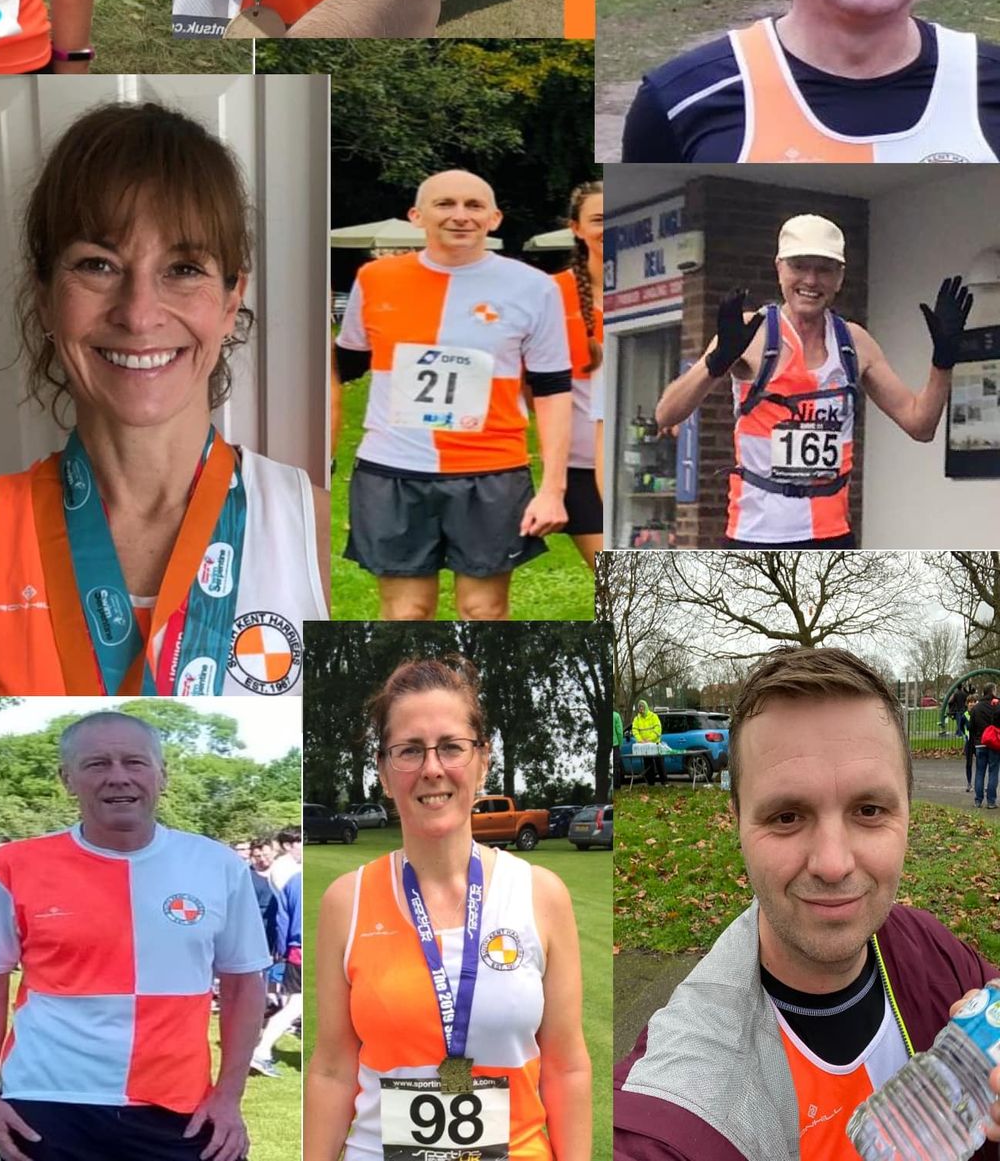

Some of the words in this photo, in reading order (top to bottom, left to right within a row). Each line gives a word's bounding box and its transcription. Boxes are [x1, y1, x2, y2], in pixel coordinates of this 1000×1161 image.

[441, 354, 471, 366] DFDS
[414, 370, 458, 405] 21
[780, 431, 838, 468] 165
[236, 613, 266, 631] KENT
[269, 615, 301, 667] HARRIERS
[244, 677, 268, 693] EST.
[431, 967, 447, 991] The
[440, 992, 455, 1025] 2019
[410, 1093, 484, 1146] 98
